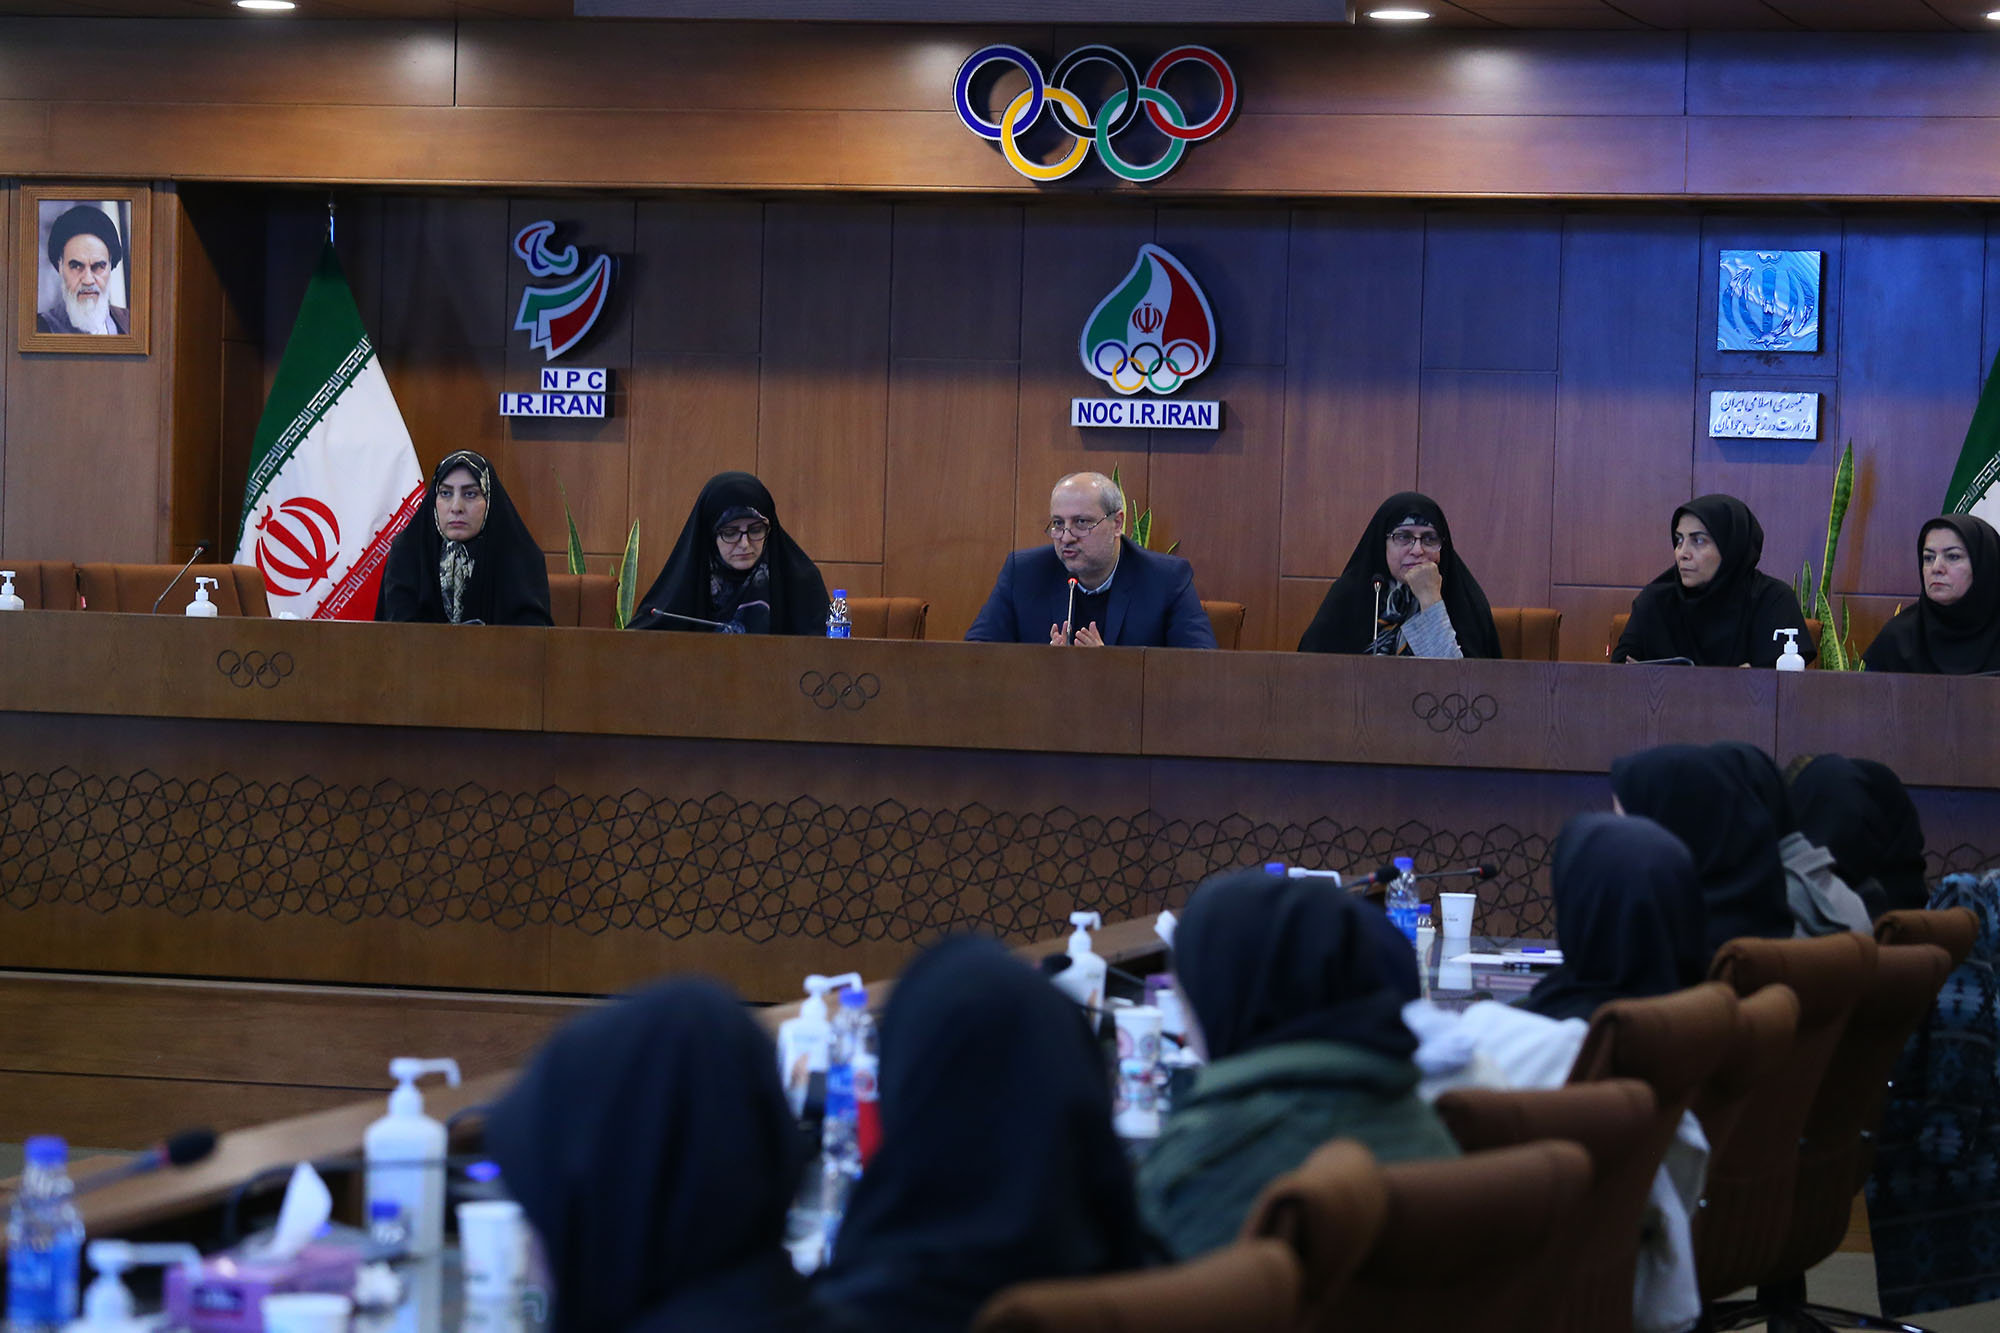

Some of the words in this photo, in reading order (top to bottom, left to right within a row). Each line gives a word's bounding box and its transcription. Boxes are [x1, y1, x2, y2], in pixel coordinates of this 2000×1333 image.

[502, 393, 602, 415] I.R.IRAN
[1078, 402, 1123, 424] NOC
[1129, 403, 1212, 426] I.R.IRAN
